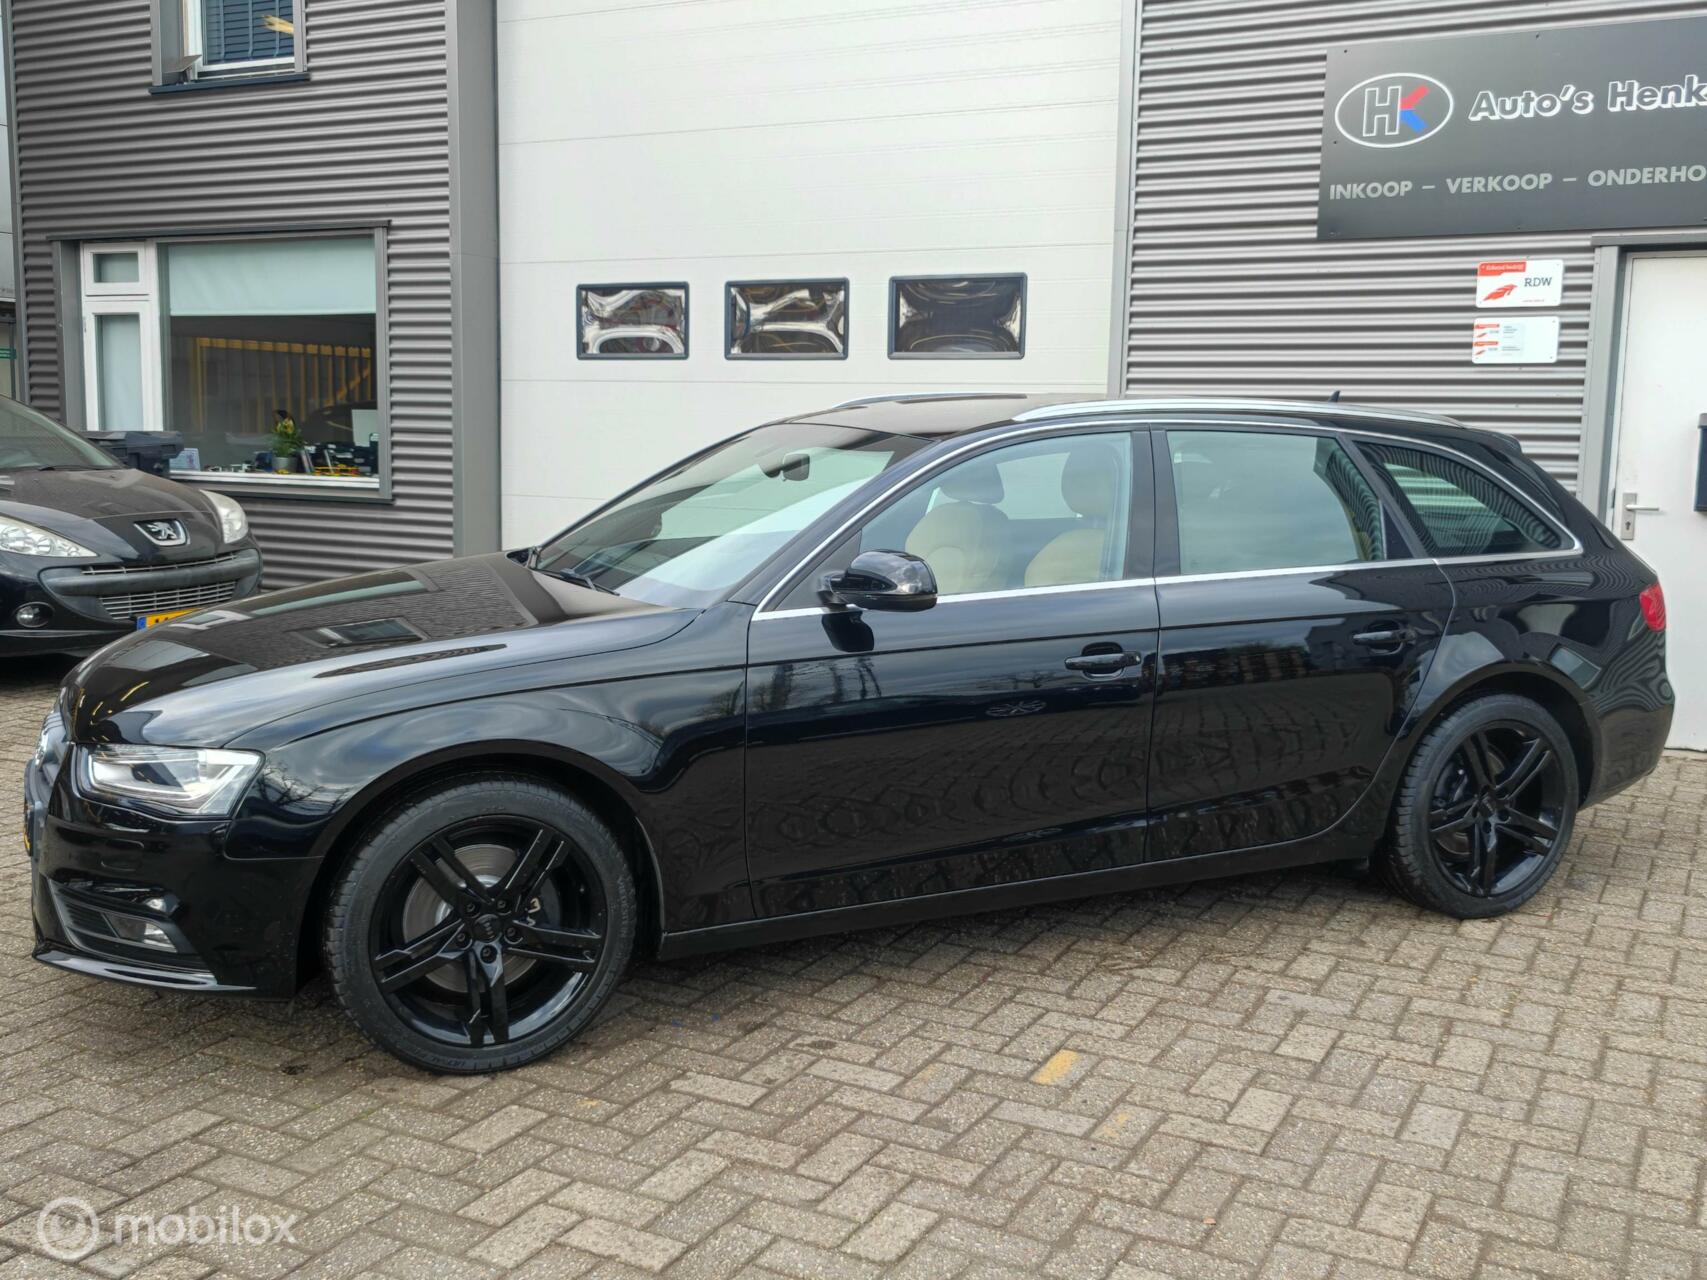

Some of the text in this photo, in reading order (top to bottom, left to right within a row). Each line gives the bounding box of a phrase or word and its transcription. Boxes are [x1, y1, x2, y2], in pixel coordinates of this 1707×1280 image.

[1468, 85, 1594, 123] Auto's
[1329, 180, 1413, 201] INKOOP
[1446, 173, 1553, 195] VERKOOP
[1587, 164, 1707, 188] ONDERHO
[1524, 276, 1552, 288] RDW
